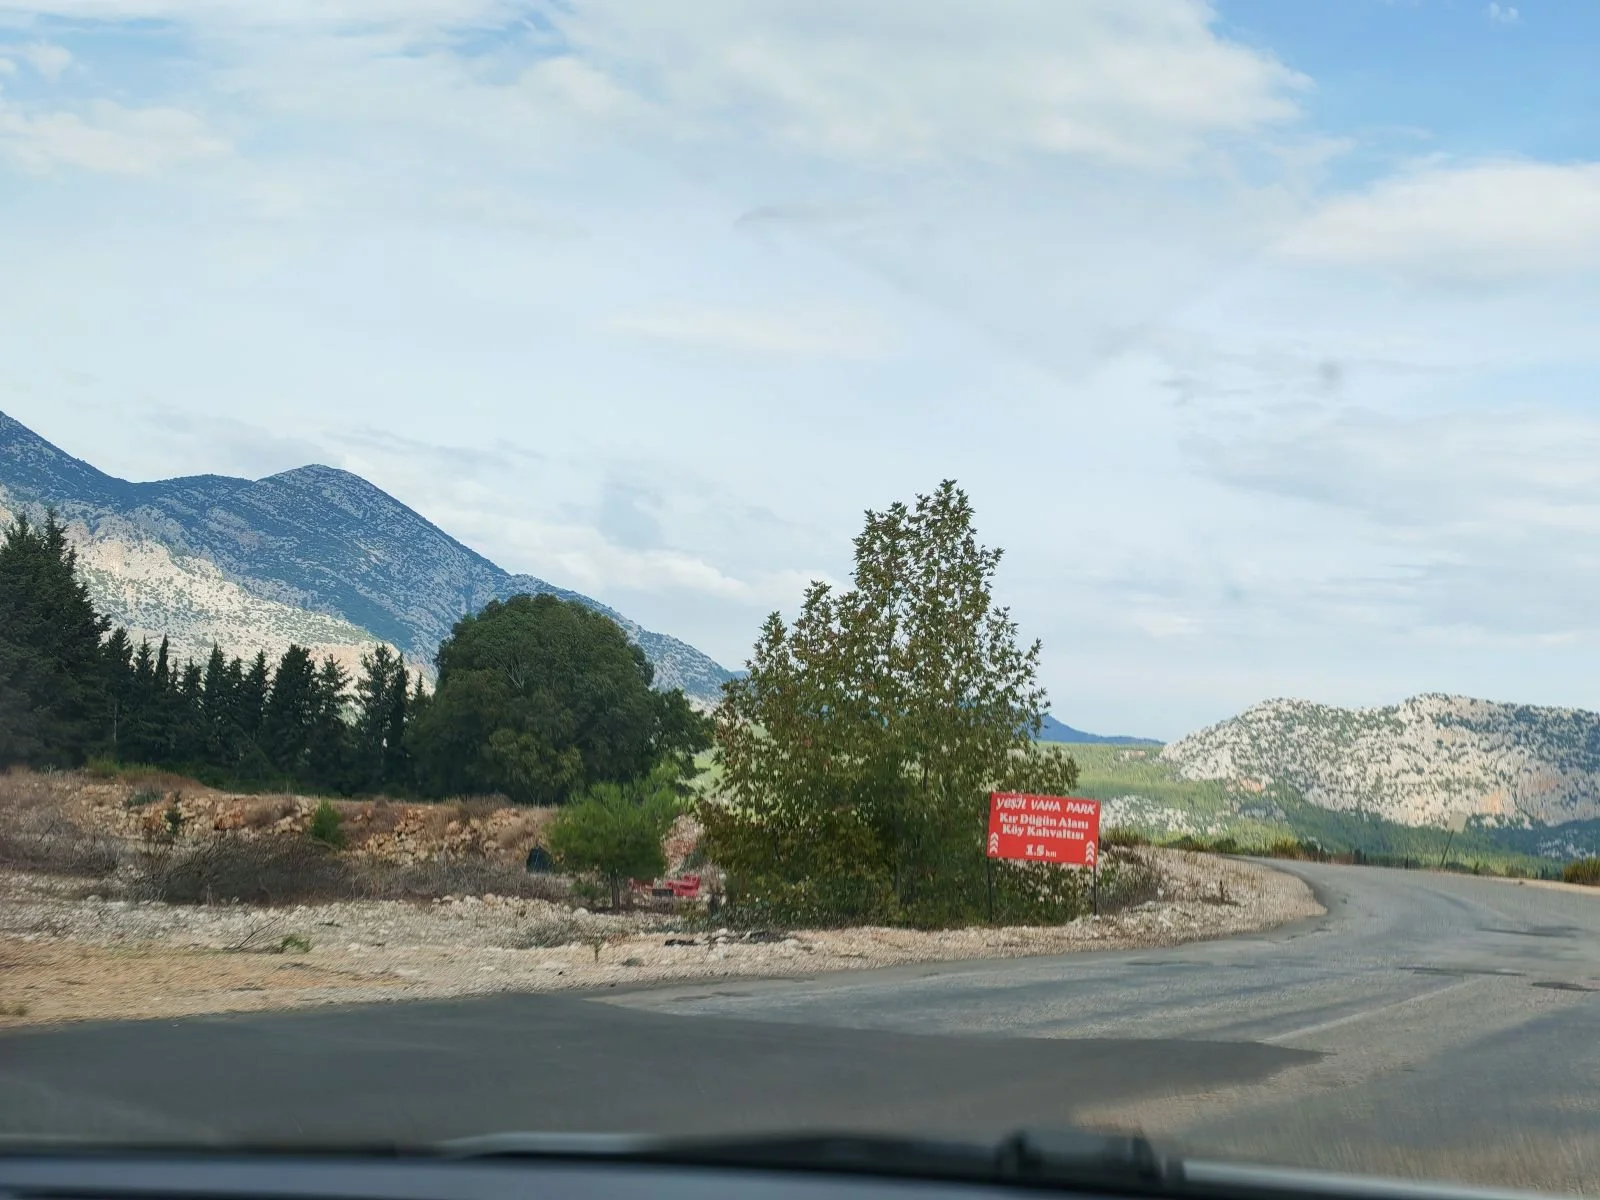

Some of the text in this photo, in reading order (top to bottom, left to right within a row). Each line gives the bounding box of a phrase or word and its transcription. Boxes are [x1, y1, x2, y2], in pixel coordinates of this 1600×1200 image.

[1031, 799, 1061, 813] VAHA
[1066, 801, 1096, 815] PARK
[1000, 812, 1089, 829] Kır Düğün Alanı
[1003, 824, 1084, 840] Köy Kahvaltısı
